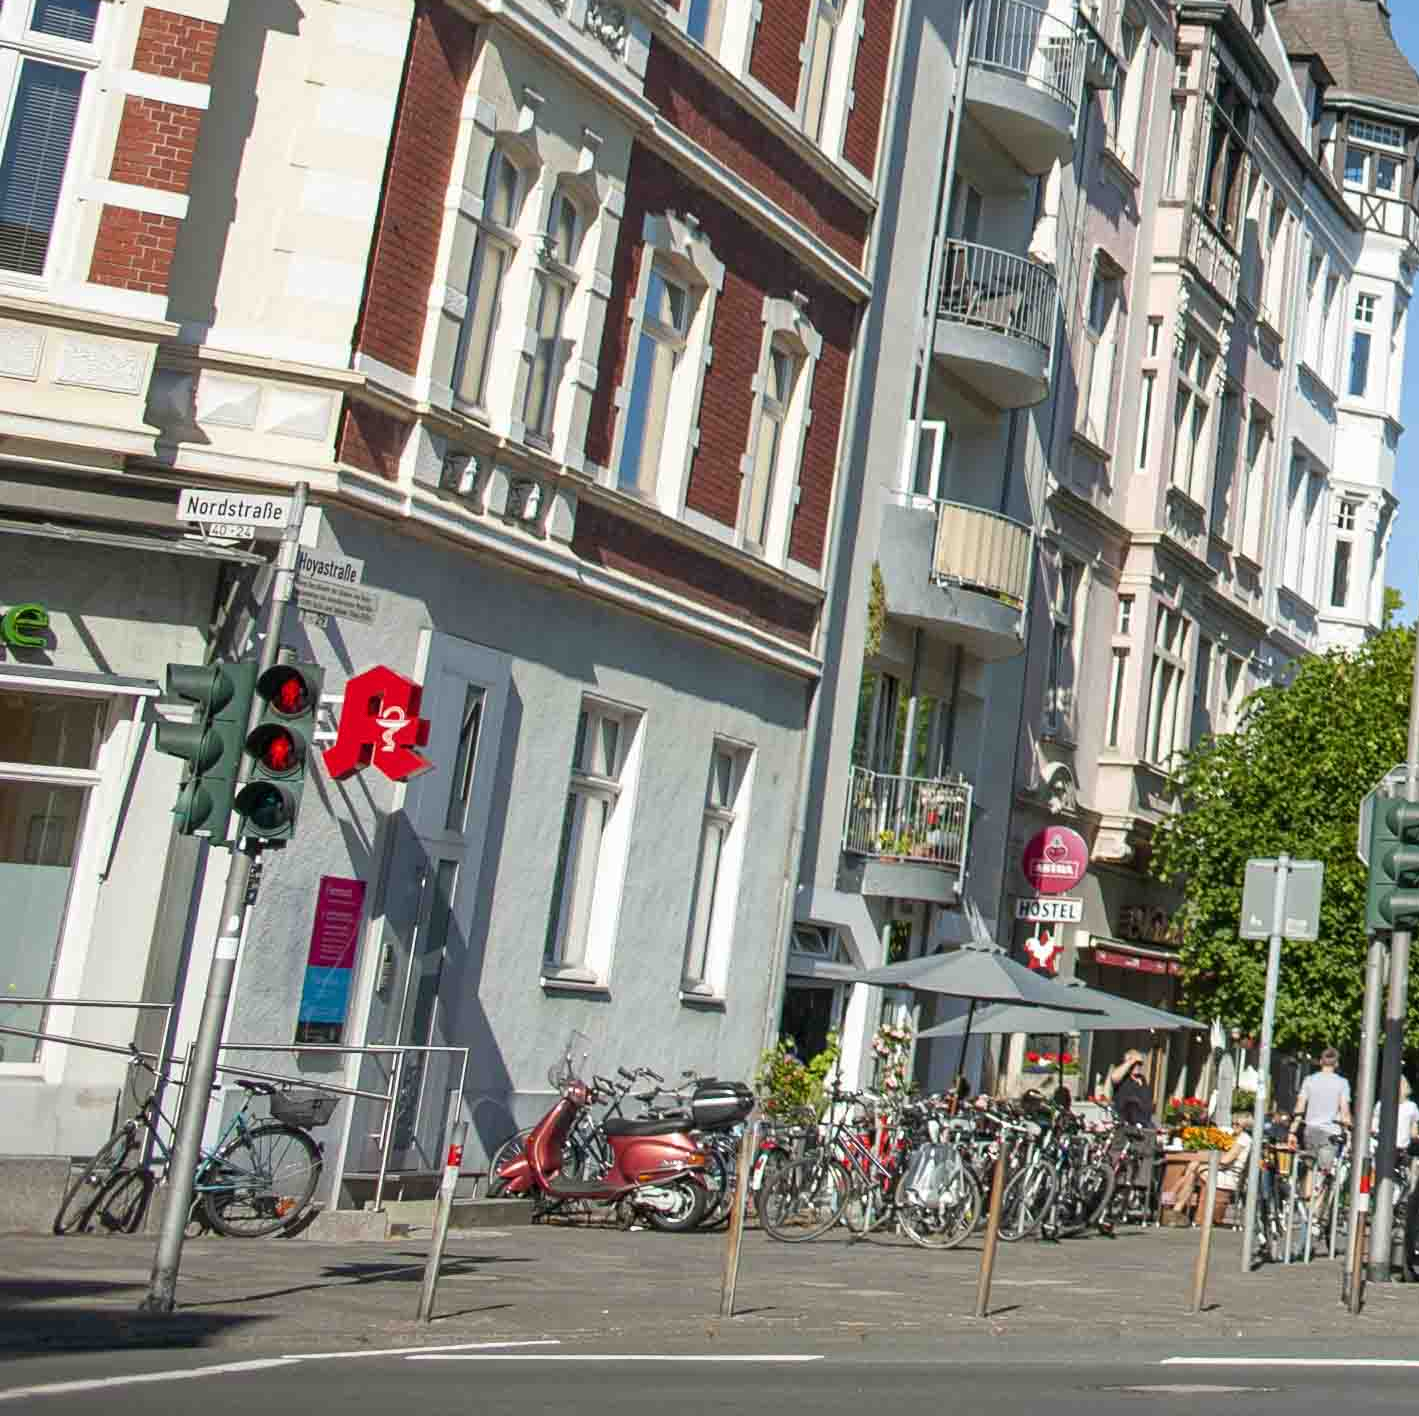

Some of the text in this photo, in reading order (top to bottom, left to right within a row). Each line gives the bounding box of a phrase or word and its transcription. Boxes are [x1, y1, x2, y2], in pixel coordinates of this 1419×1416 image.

[187, 495, 283, 520] Nordstraße
[299, 551, 357, 583] Hoyastraße
[1019, 902, 1076, 919] HOSTEL
